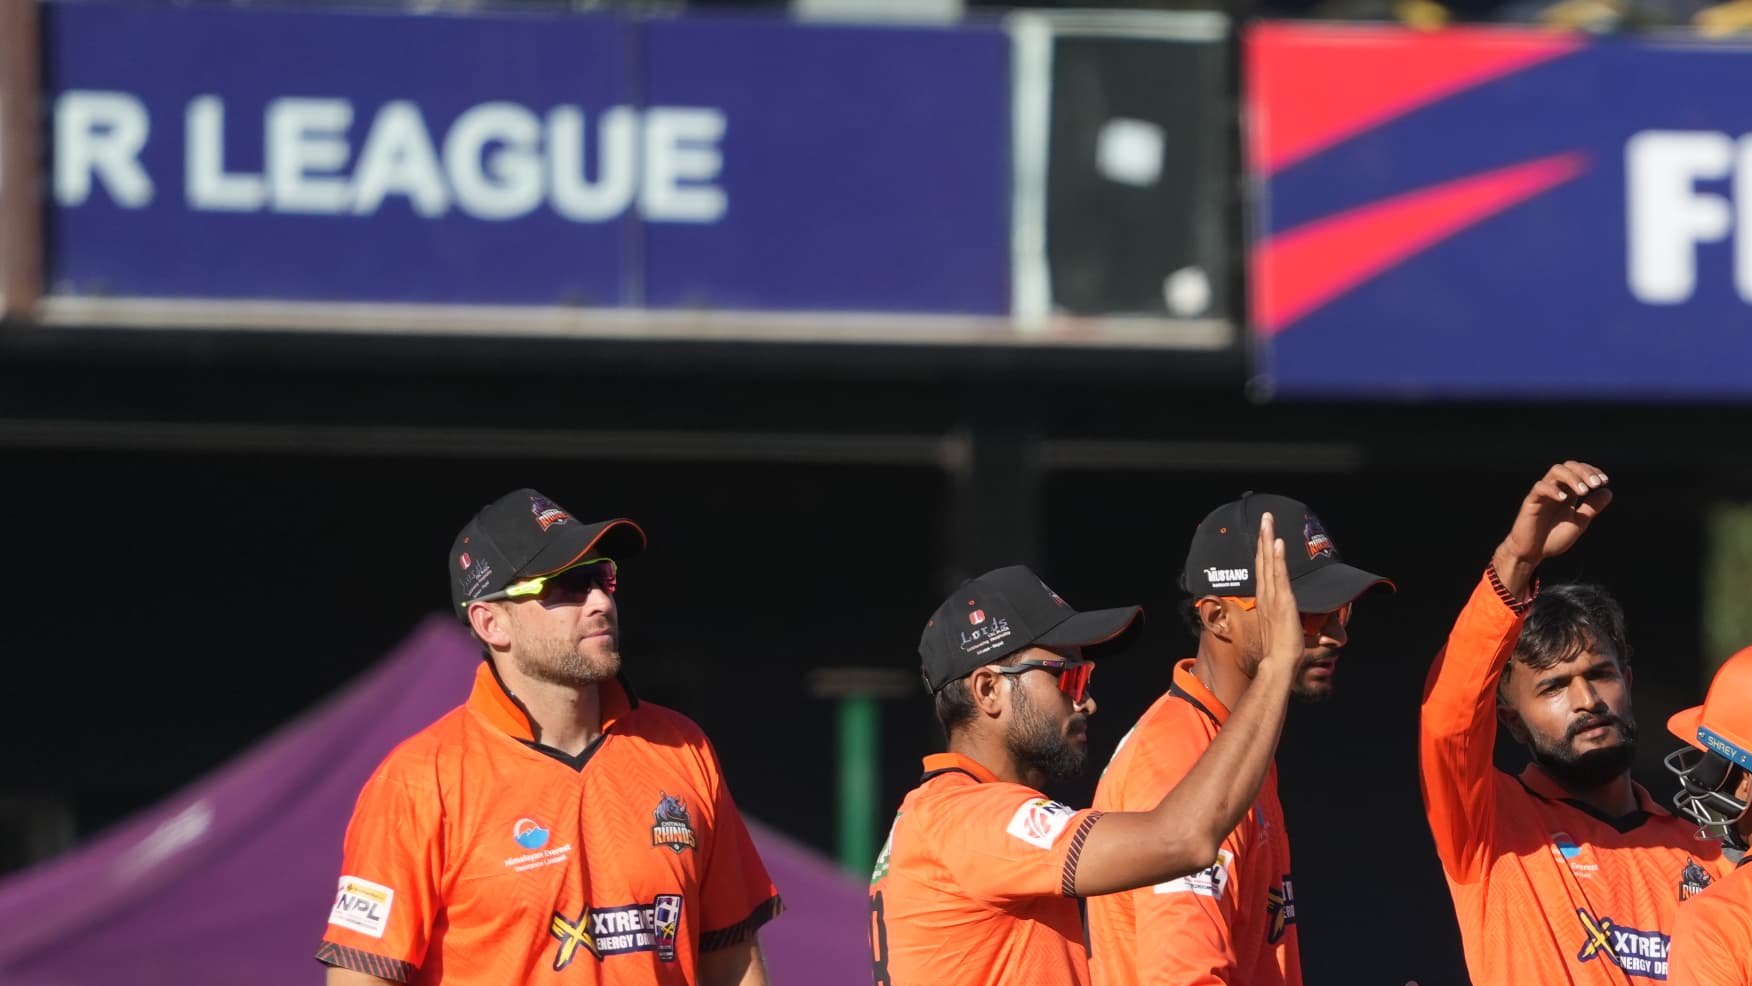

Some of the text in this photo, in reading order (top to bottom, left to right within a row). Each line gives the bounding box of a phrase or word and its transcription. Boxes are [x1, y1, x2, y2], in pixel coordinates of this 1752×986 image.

[186, 96, 728, 224] LEAGUE
[1204, 567, 1248, 582] MUSTANG
[961, 617, 1009, 643] Lords
[654, 826, 696, 848] RHINOS
[337, 893, 380, 921] NPL
[596, 933, 634, 950] ENERGY
[1617, 956, 1652, 973] NERGY
